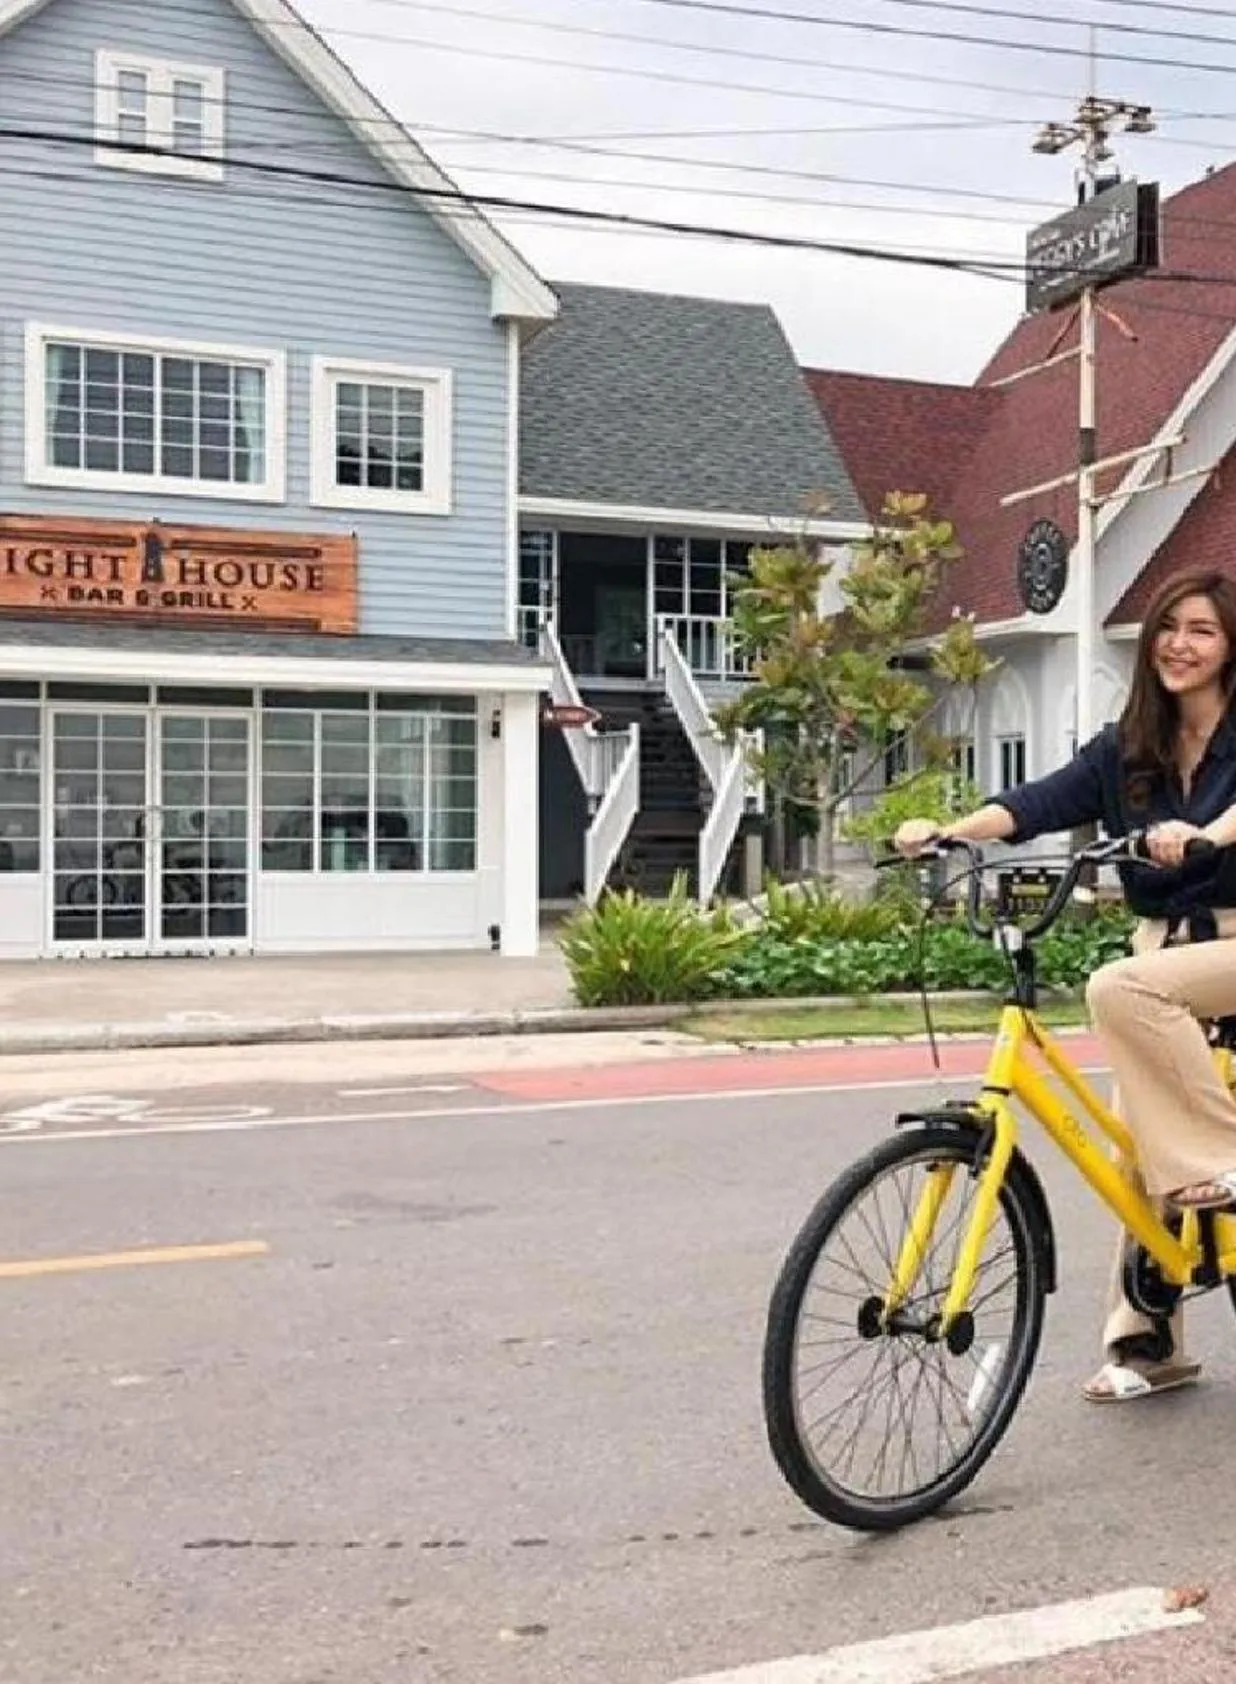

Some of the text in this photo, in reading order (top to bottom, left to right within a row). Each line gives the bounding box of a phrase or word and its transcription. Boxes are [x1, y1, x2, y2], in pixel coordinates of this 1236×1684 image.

[6, 548, 324, 592] IGHT HOUSE
[67, 585, 124, 605] BAR
[157, 589, 233, 610] GRILL
